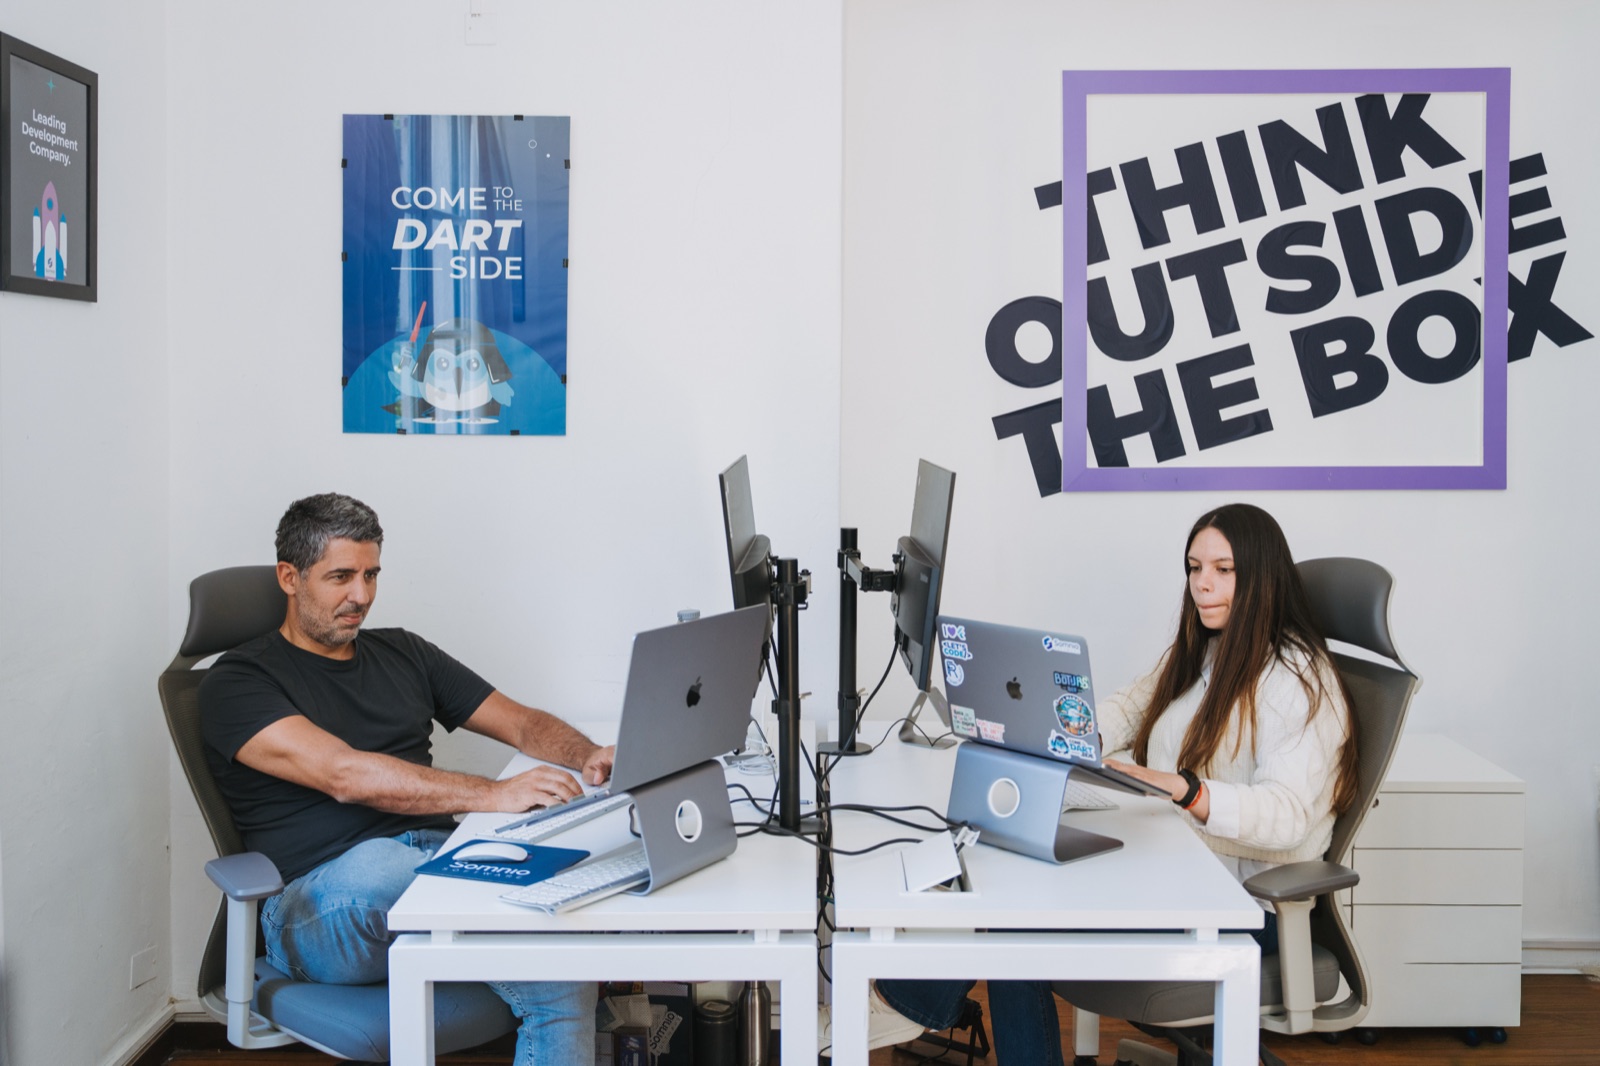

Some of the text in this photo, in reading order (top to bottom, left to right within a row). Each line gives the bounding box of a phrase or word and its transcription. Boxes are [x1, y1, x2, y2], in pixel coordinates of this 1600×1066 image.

[32, 108, 67, 134] Leading
[22, 122, 78, 152] Development
[29, 141, 71, 166] Company.
[1034, 93, 1466, 265] THINK
[391, 186, 514, 210] COME TO
[493, 199, 523, 211] THE
[392, 218, 523, 251] DART
[449, 256, 523, 280] SIDE
[985, 151, 1567, 389] OUTSIDE
[991, 250, 1595, 498] THE BOX
[449, 861, 531, 876] Somnio
[650, 1011, 675, 1050] Somnio
